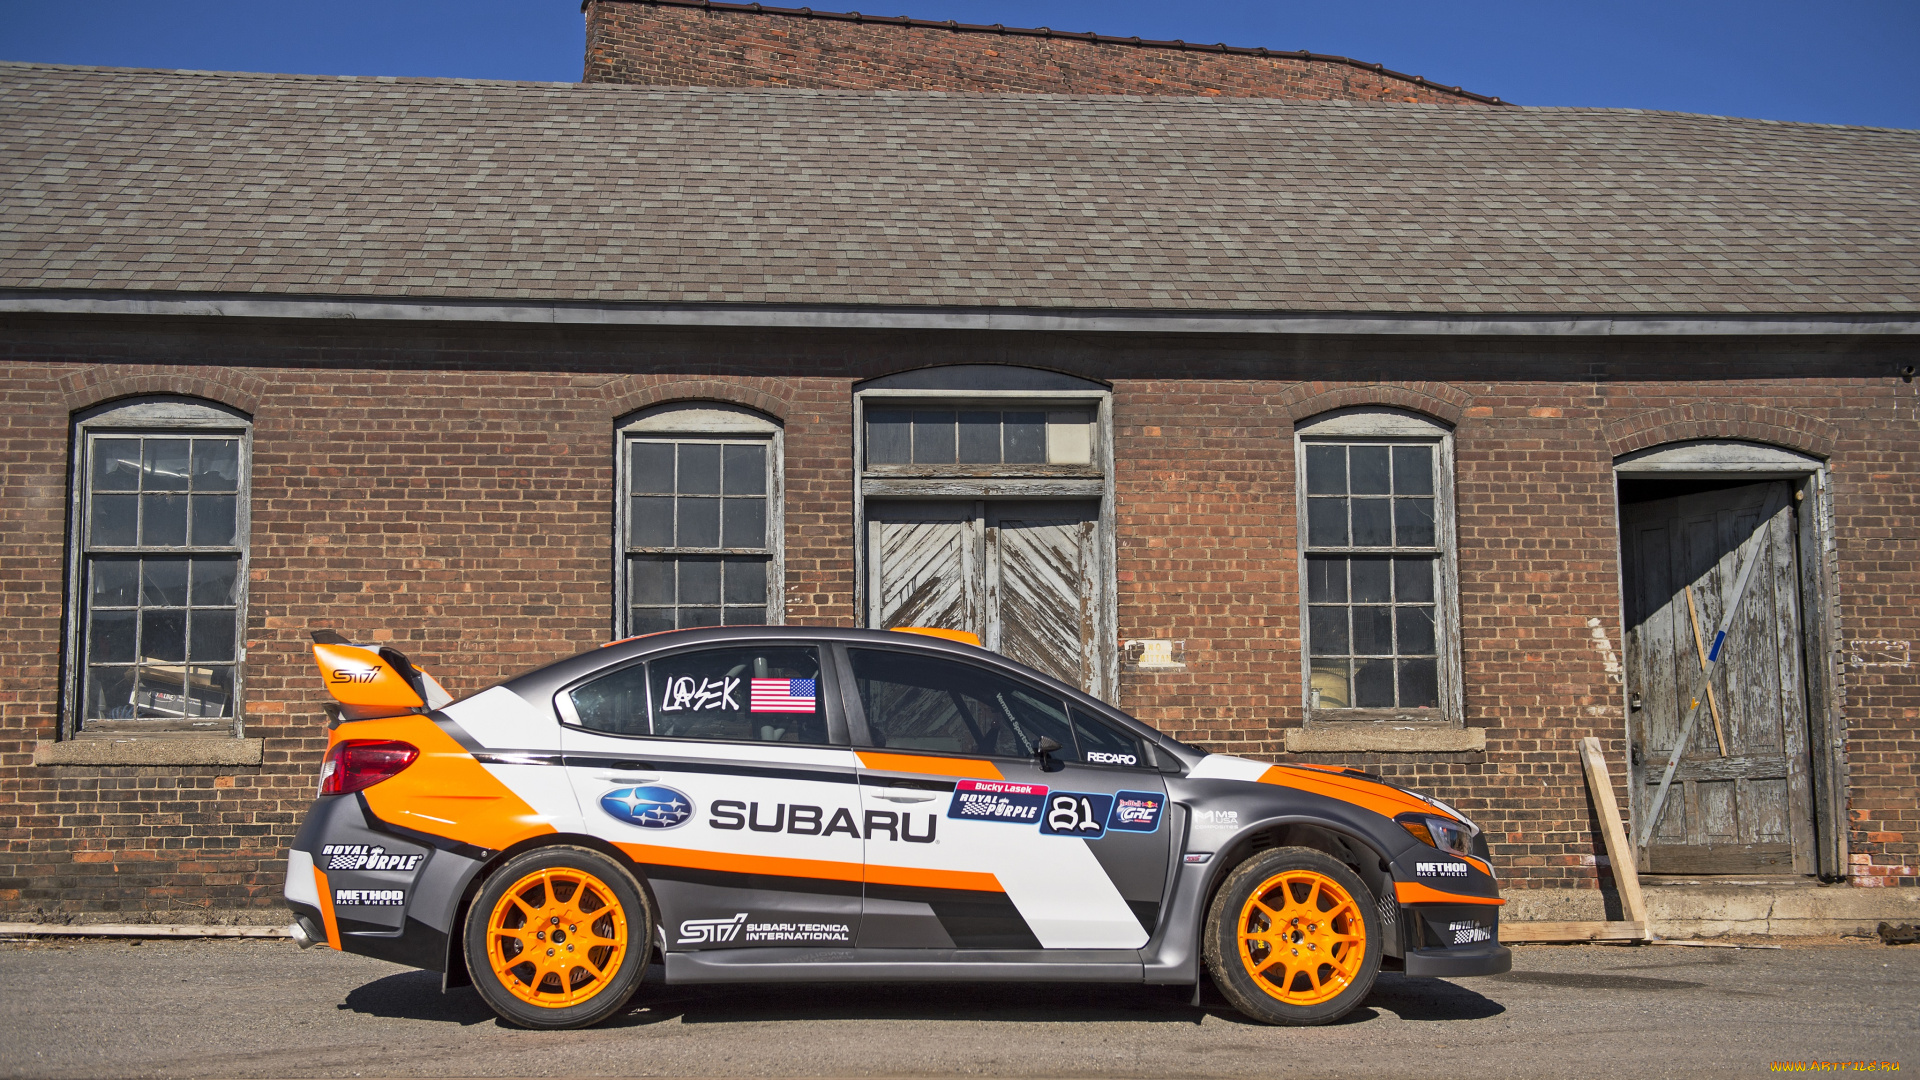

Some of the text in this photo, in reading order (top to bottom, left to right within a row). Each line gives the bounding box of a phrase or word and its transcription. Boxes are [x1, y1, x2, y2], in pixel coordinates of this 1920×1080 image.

[1087, 751, 1137, 765] RECARO
[975, 782, 1032, 794] Bucky Lasek
[959, 793, 998, 804] ROYAL
[985, 803, 1038, 818] PURPLE
[1048, 796, 1100, 831] 81
[1121, 807, 1158, 820] GRC
[708, 799, 938, 844] SUBARU
[322, 845, 369, 854] ROYAL
[354, 854, 418, 870] PURPLE
[1415, 862, 1467, 872] METHOD
[336, 890, 404, 900] METHOD
[746, 923, 849, 933] SUBARU TECNICA
[746, 932, 849, 941] INTERNATIONAL
